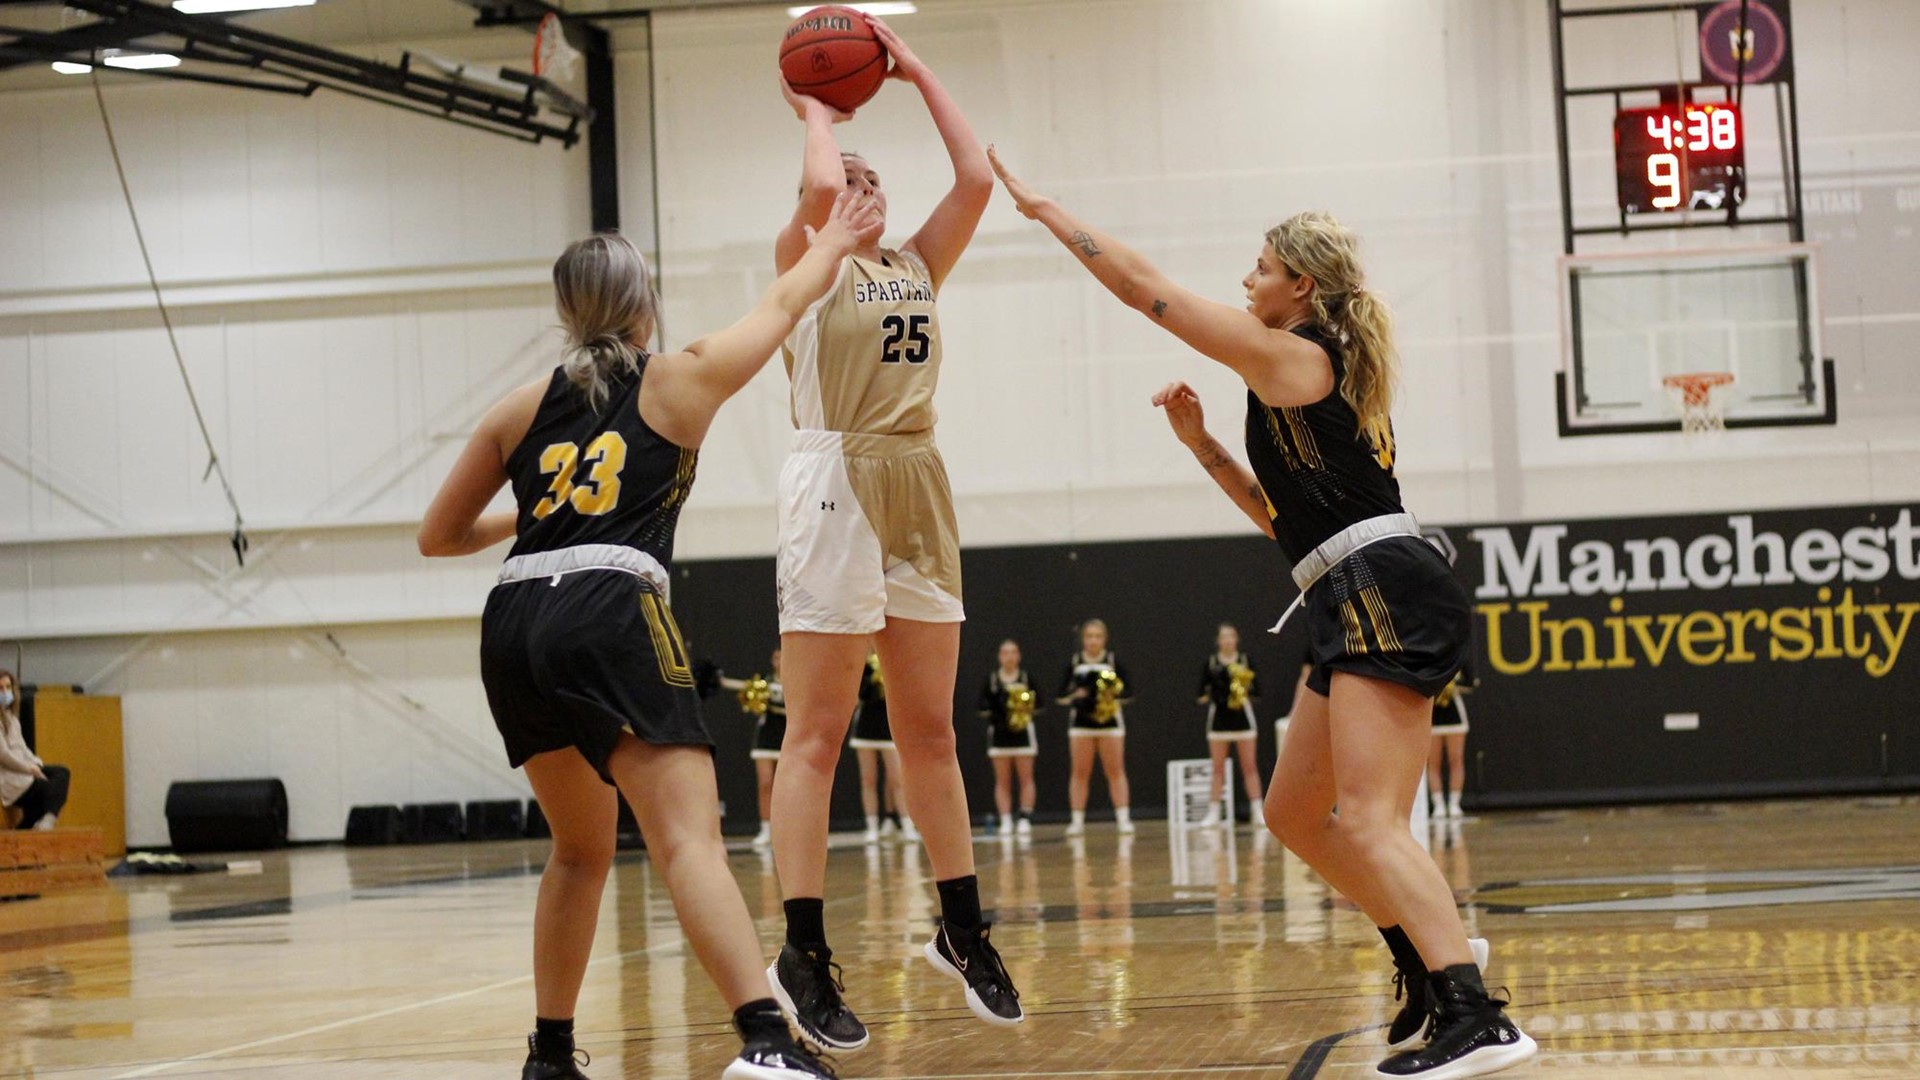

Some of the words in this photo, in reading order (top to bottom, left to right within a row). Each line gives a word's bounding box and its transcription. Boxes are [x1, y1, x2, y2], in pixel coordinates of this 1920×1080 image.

[1646, 109, 1736, 151] 4:38
[1647, 153, 1680, 208] 9
[856, 279, 936, 303] SPARTAN
[880, 314, 930, 364] 25
[532, 431, 628, 520] 33
[1476, 586, 1920, 678] University
